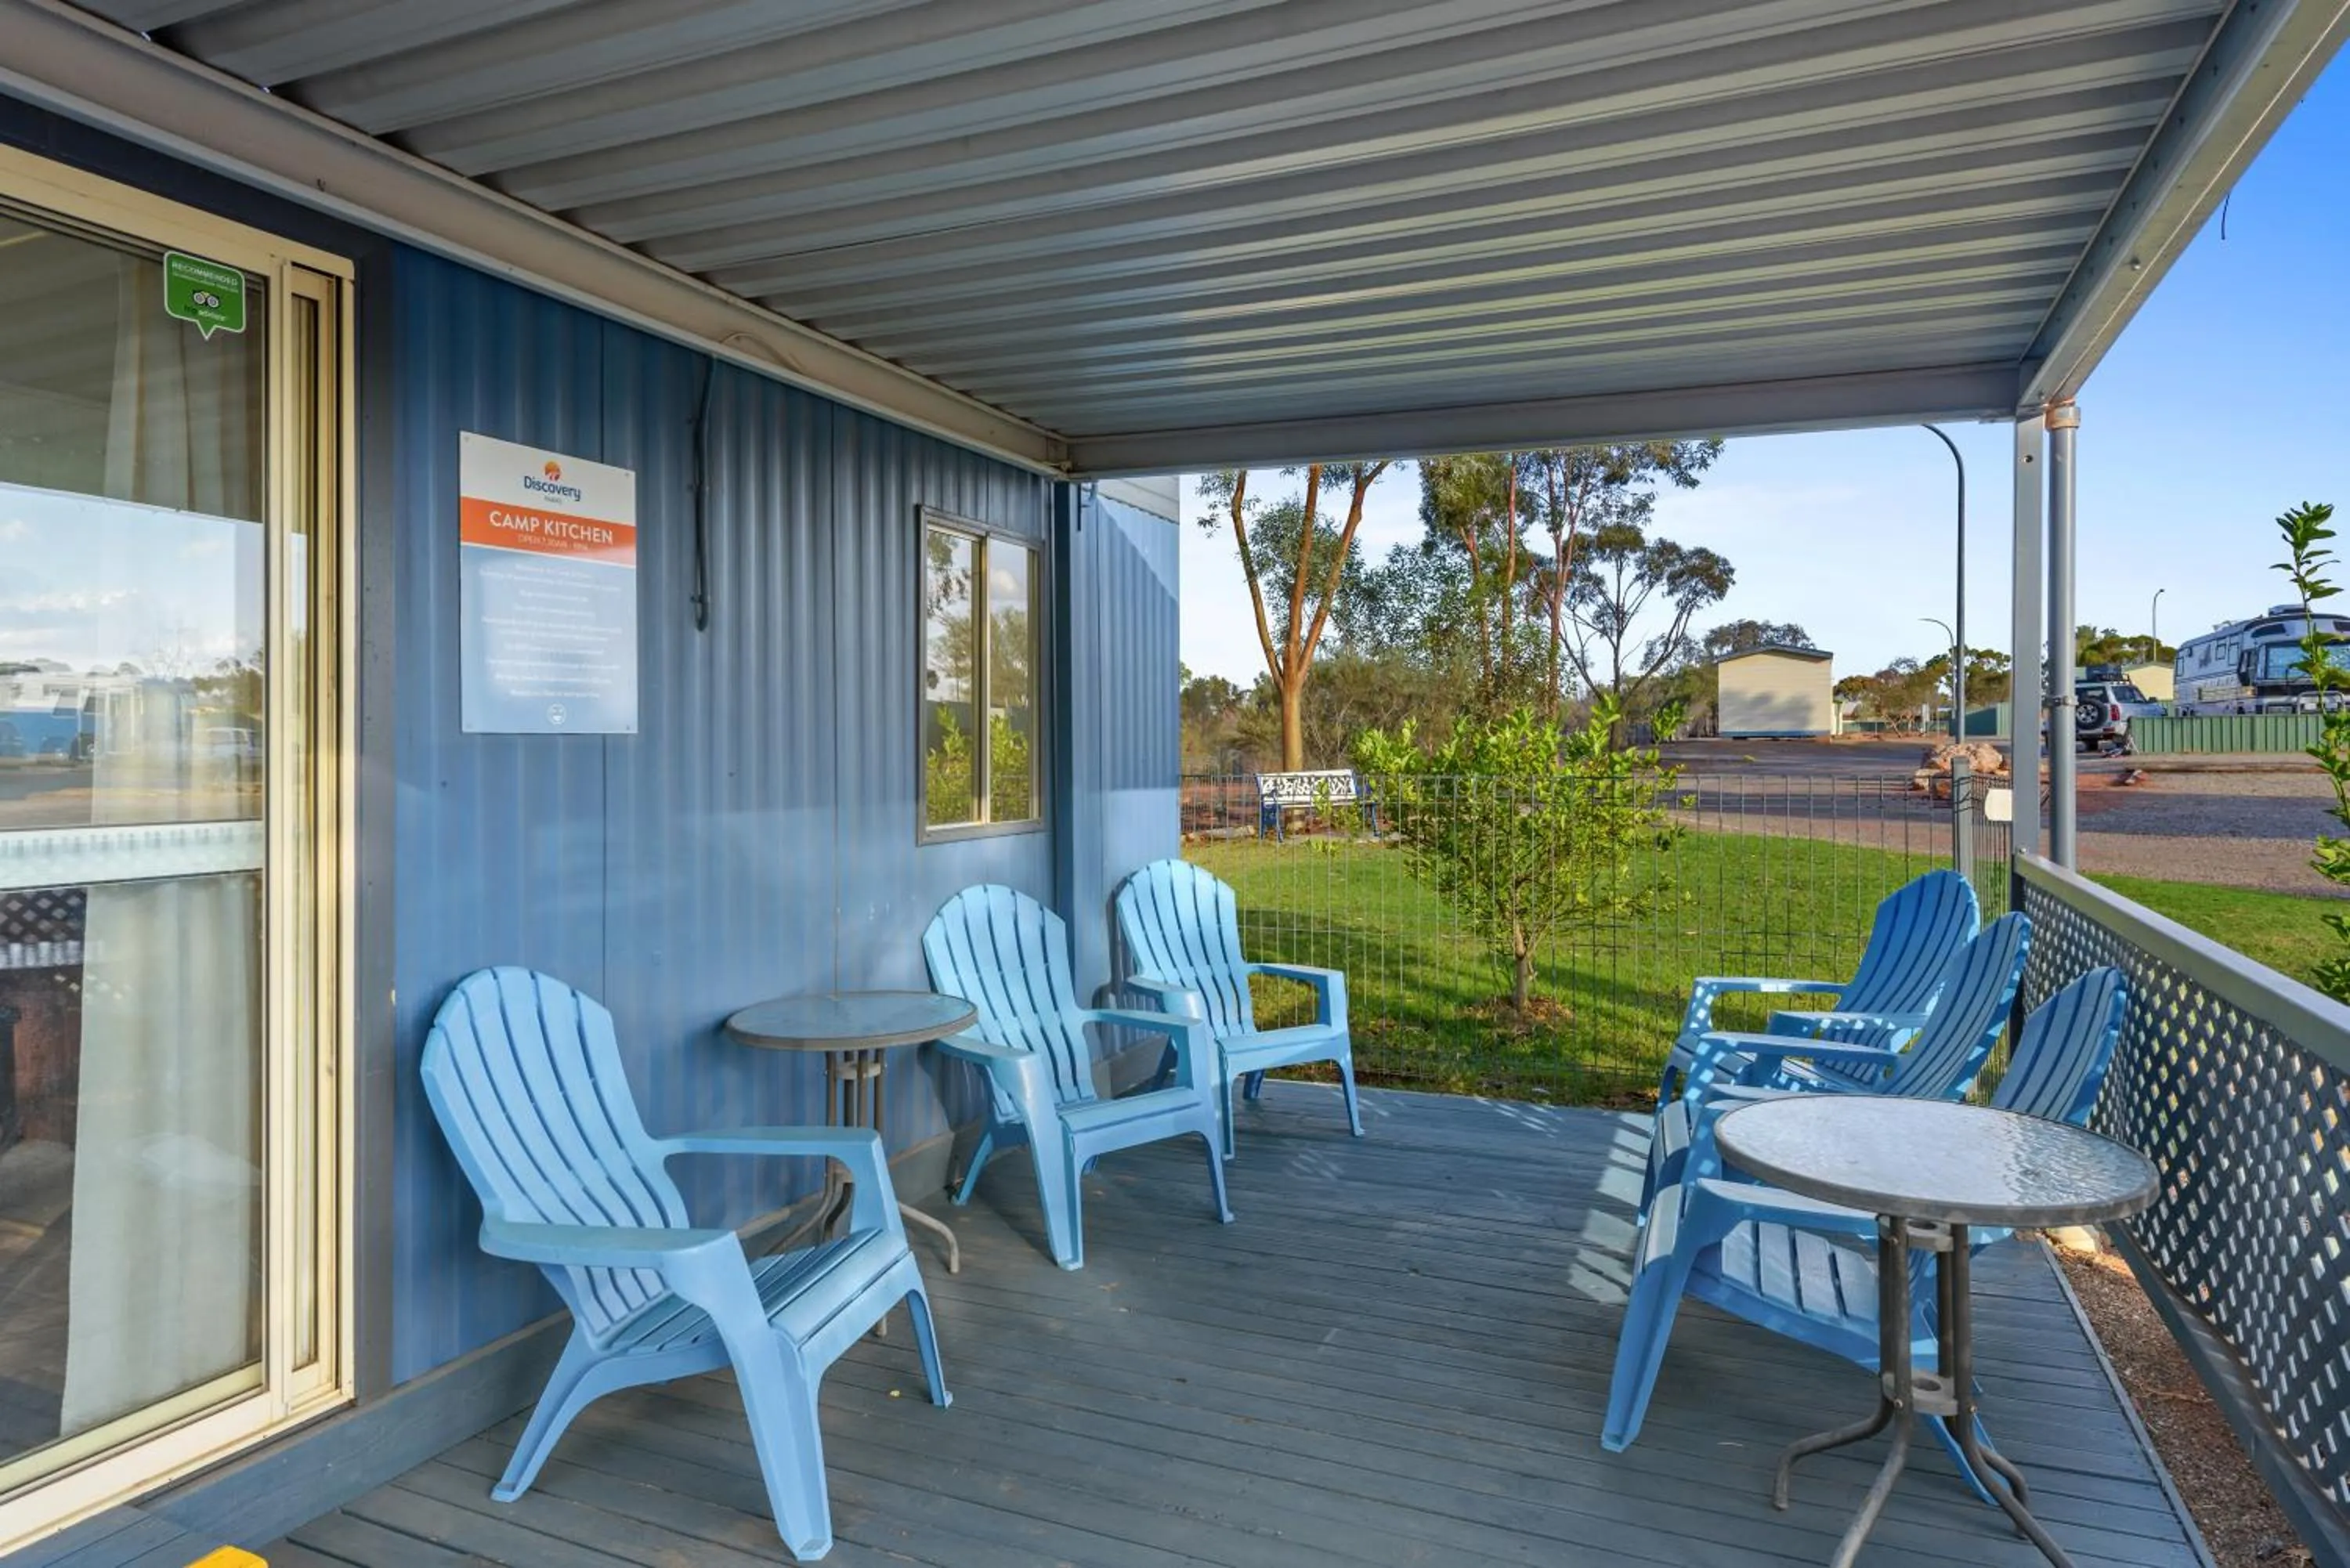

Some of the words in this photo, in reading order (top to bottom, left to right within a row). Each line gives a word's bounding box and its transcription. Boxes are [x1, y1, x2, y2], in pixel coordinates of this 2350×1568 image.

[524, 475, 581, 502] Discovery
[489, 510, 539, 533] CAMP
[544, 518, 614, 545] KITCHEN
